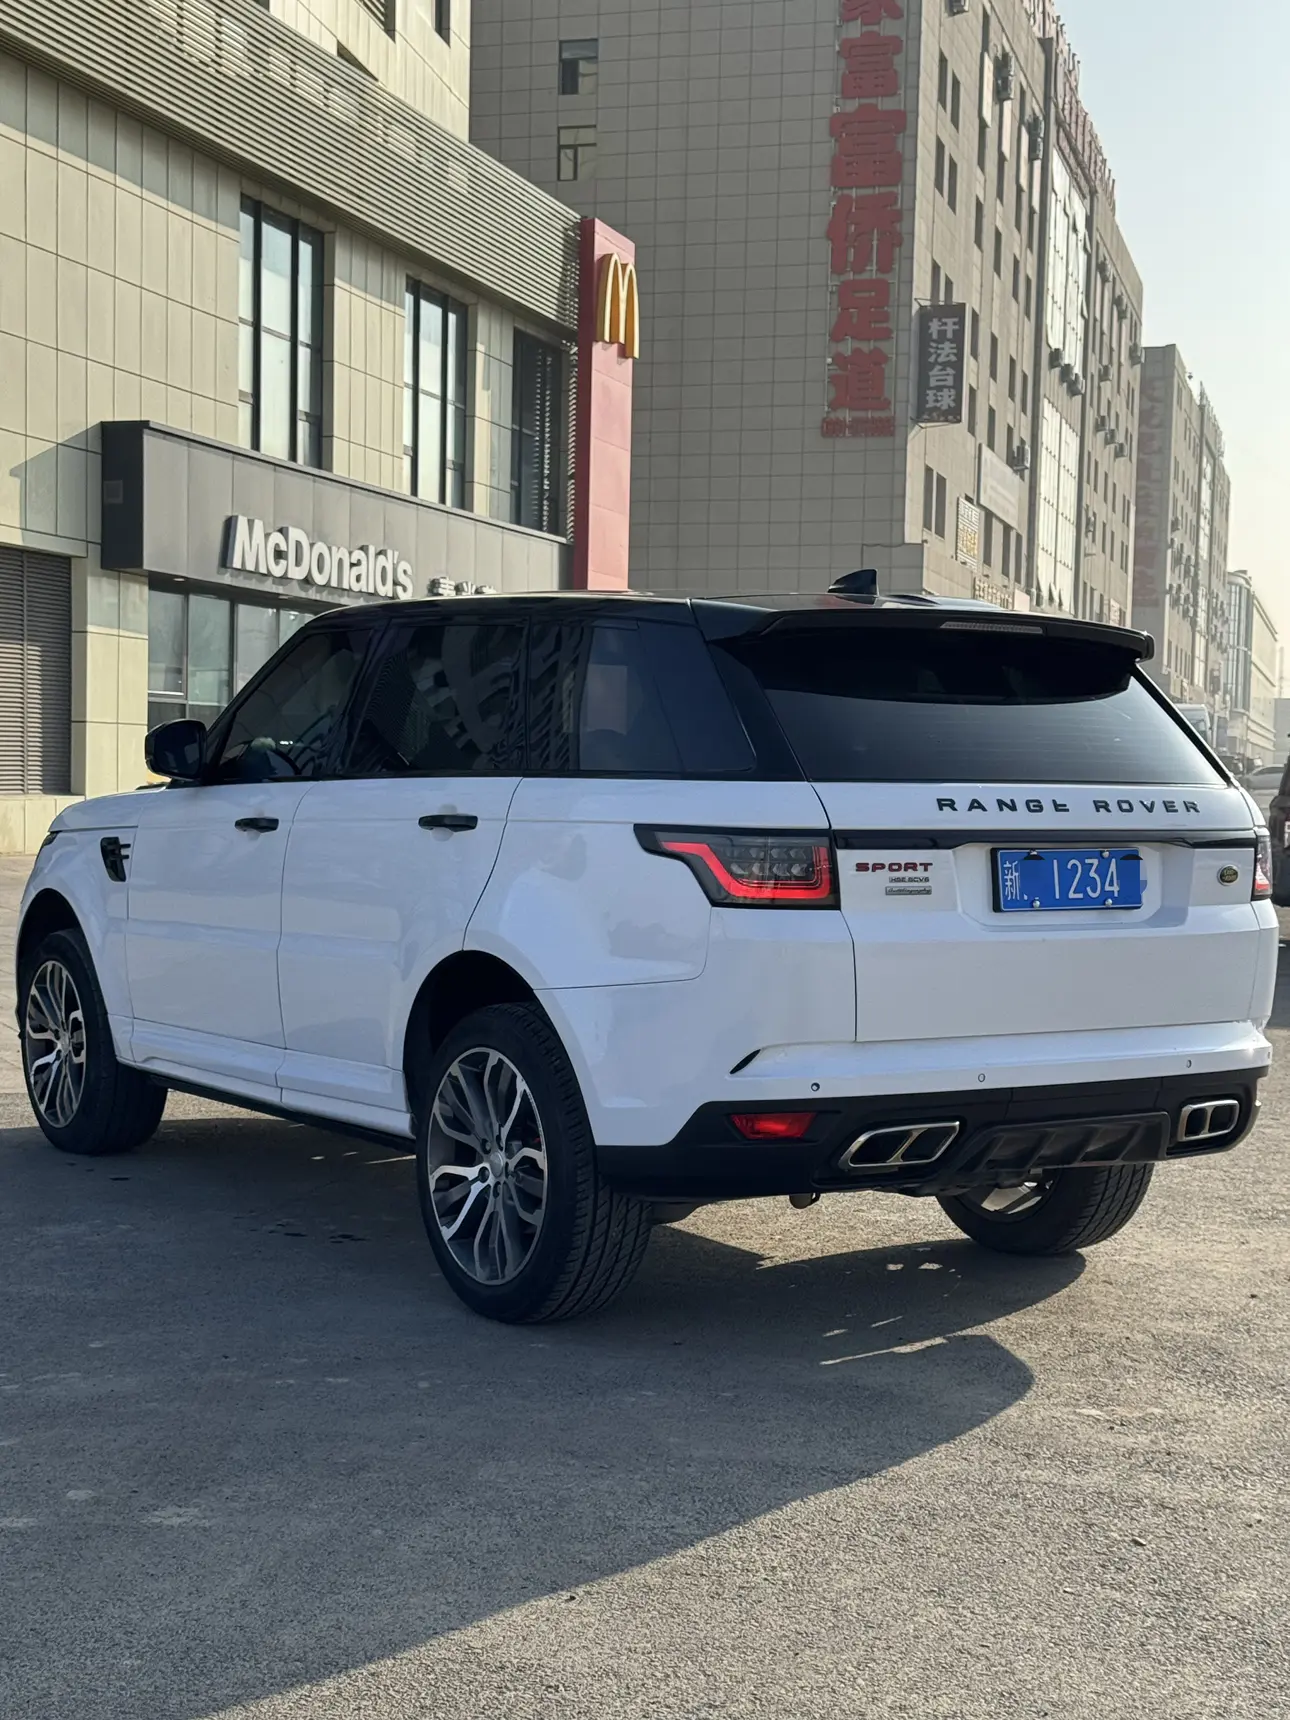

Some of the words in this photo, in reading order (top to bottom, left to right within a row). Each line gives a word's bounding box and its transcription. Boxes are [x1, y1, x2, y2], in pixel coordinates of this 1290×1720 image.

[925, 317, 960, 410] 杆法台球
[231, 514, 414, 599] McDonald's
[936, 797, 1070, 813] RANGE
[1092, 799, 1201, 814] ROVER
[855, 862, 933, 872] SPORT
[1053, 858, 1120, 900] 1234
